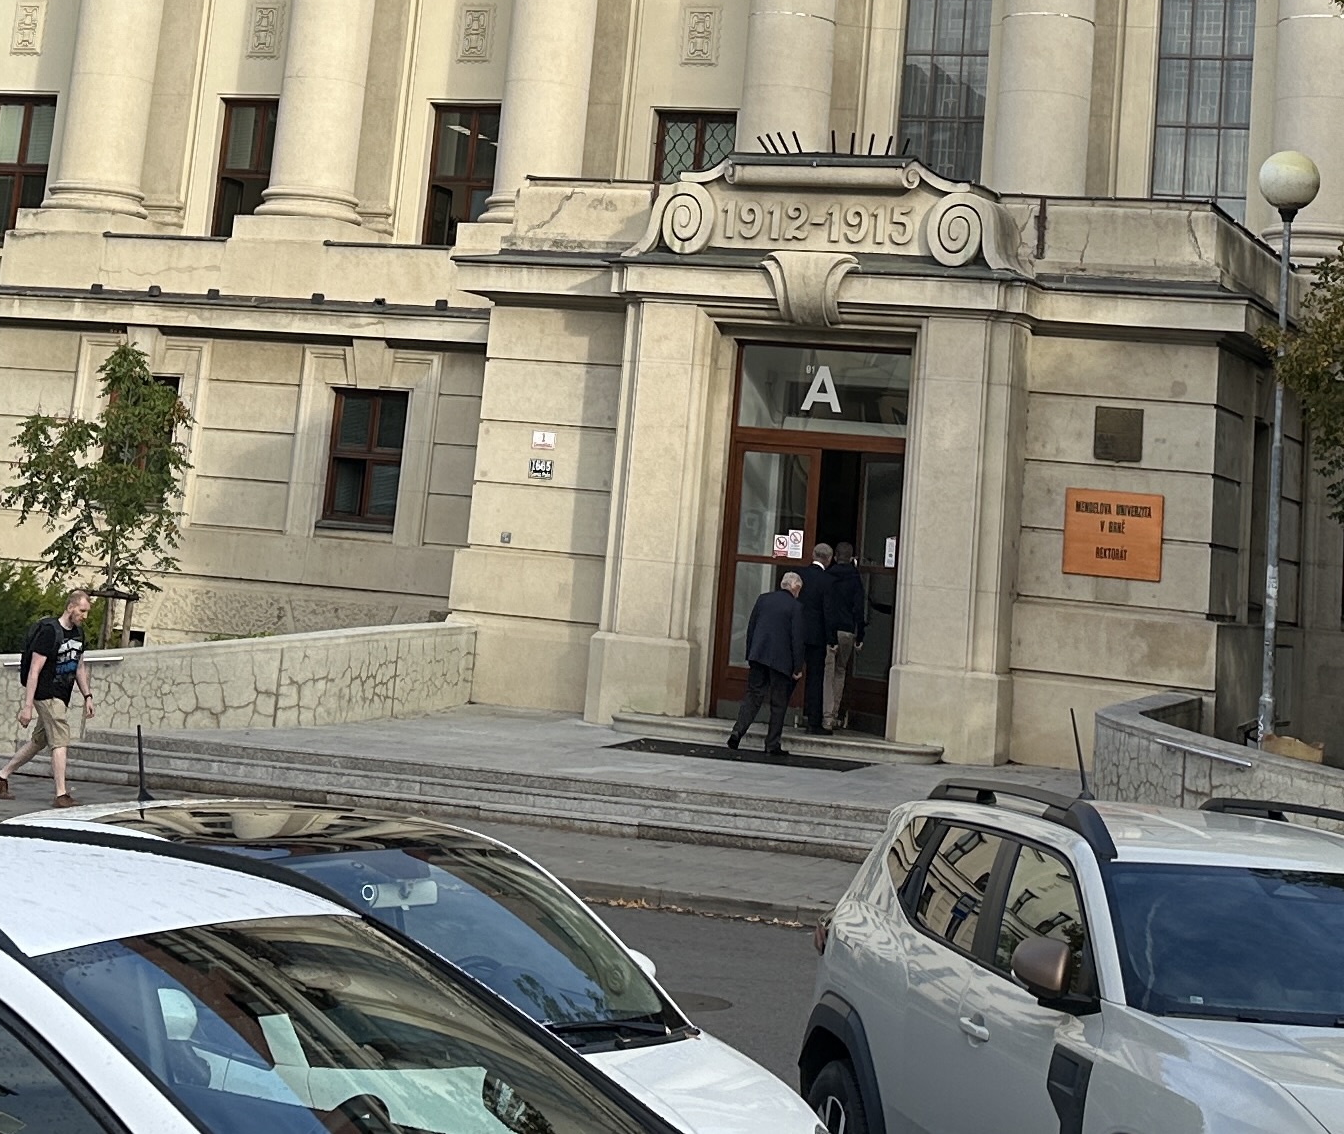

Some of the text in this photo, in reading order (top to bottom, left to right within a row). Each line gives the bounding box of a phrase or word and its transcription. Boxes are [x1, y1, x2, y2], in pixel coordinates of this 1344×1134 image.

[721, 199, 915, 246] 1912-1915
[800, 365, 842, 413] A
[1100, 520, 1105, 533] V
